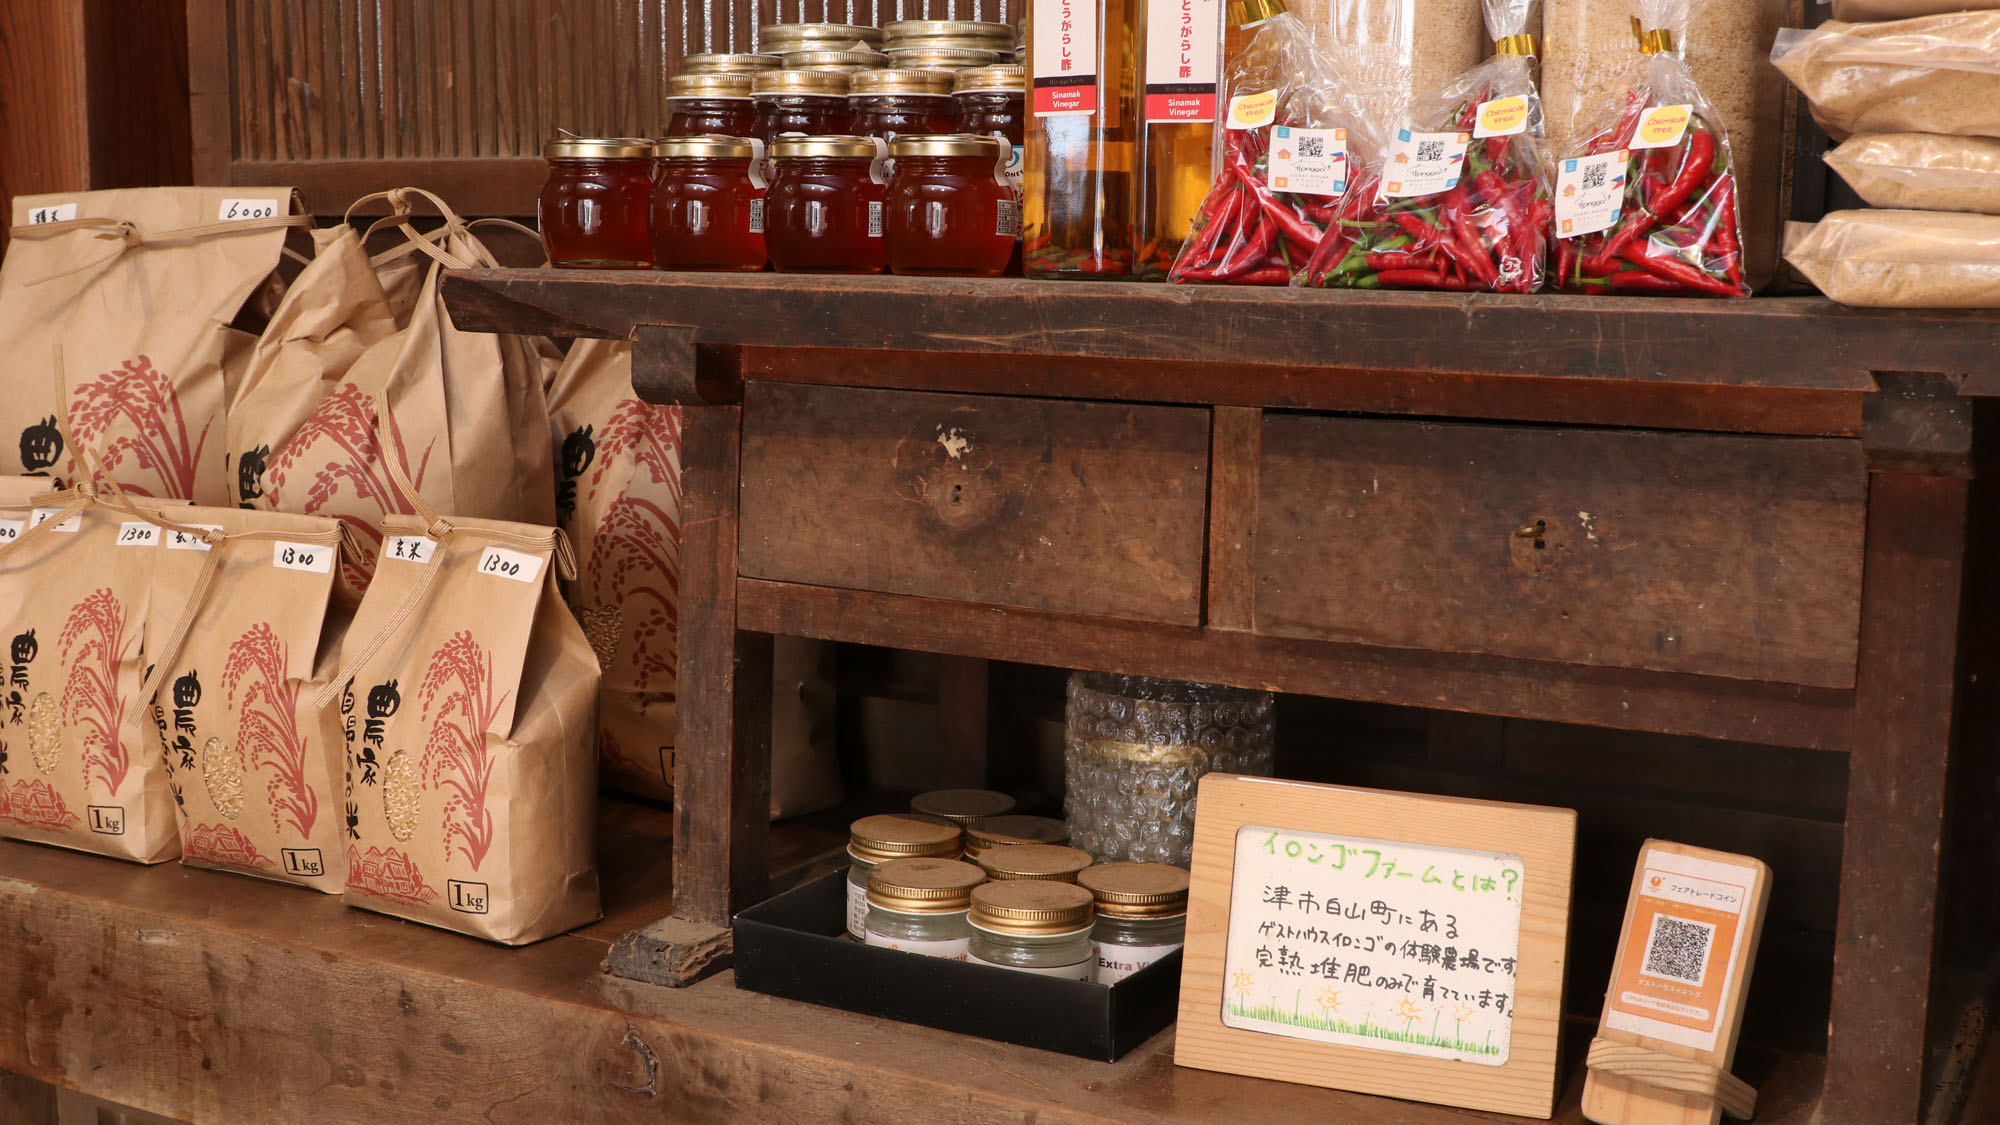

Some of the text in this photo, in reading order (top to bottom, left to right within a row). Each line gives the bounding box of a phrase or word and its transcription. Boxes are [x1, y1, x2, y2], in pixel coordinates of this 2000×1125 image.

[1052, 90, 1081, 99] Sinamak
[1052, 100, 1080, 109] Vinegar
[1168, 98, 1201, 107] Sinamak
[1168, 107, 1200, 117] Vinegar
[1486, 105, 1524, 117] Chemical
[1493, 115, 1514, 124] Free
[1647, 116, 1686, 126] Chemical
[227, 202, 272, 218] 6000
[121, 529, 152, 541] 1300
[282, 549, 314, 566] 1300
[483, 554, 520, 576] 1300
[1262, 831, 1518, 901] イロンゴファームとは?
[1671, 884, 1737, 903] フェアトレードコイン
[1262, 885, 1459, 939] 津市白山町にある
[1098, 957, 1132, 971] Extra
